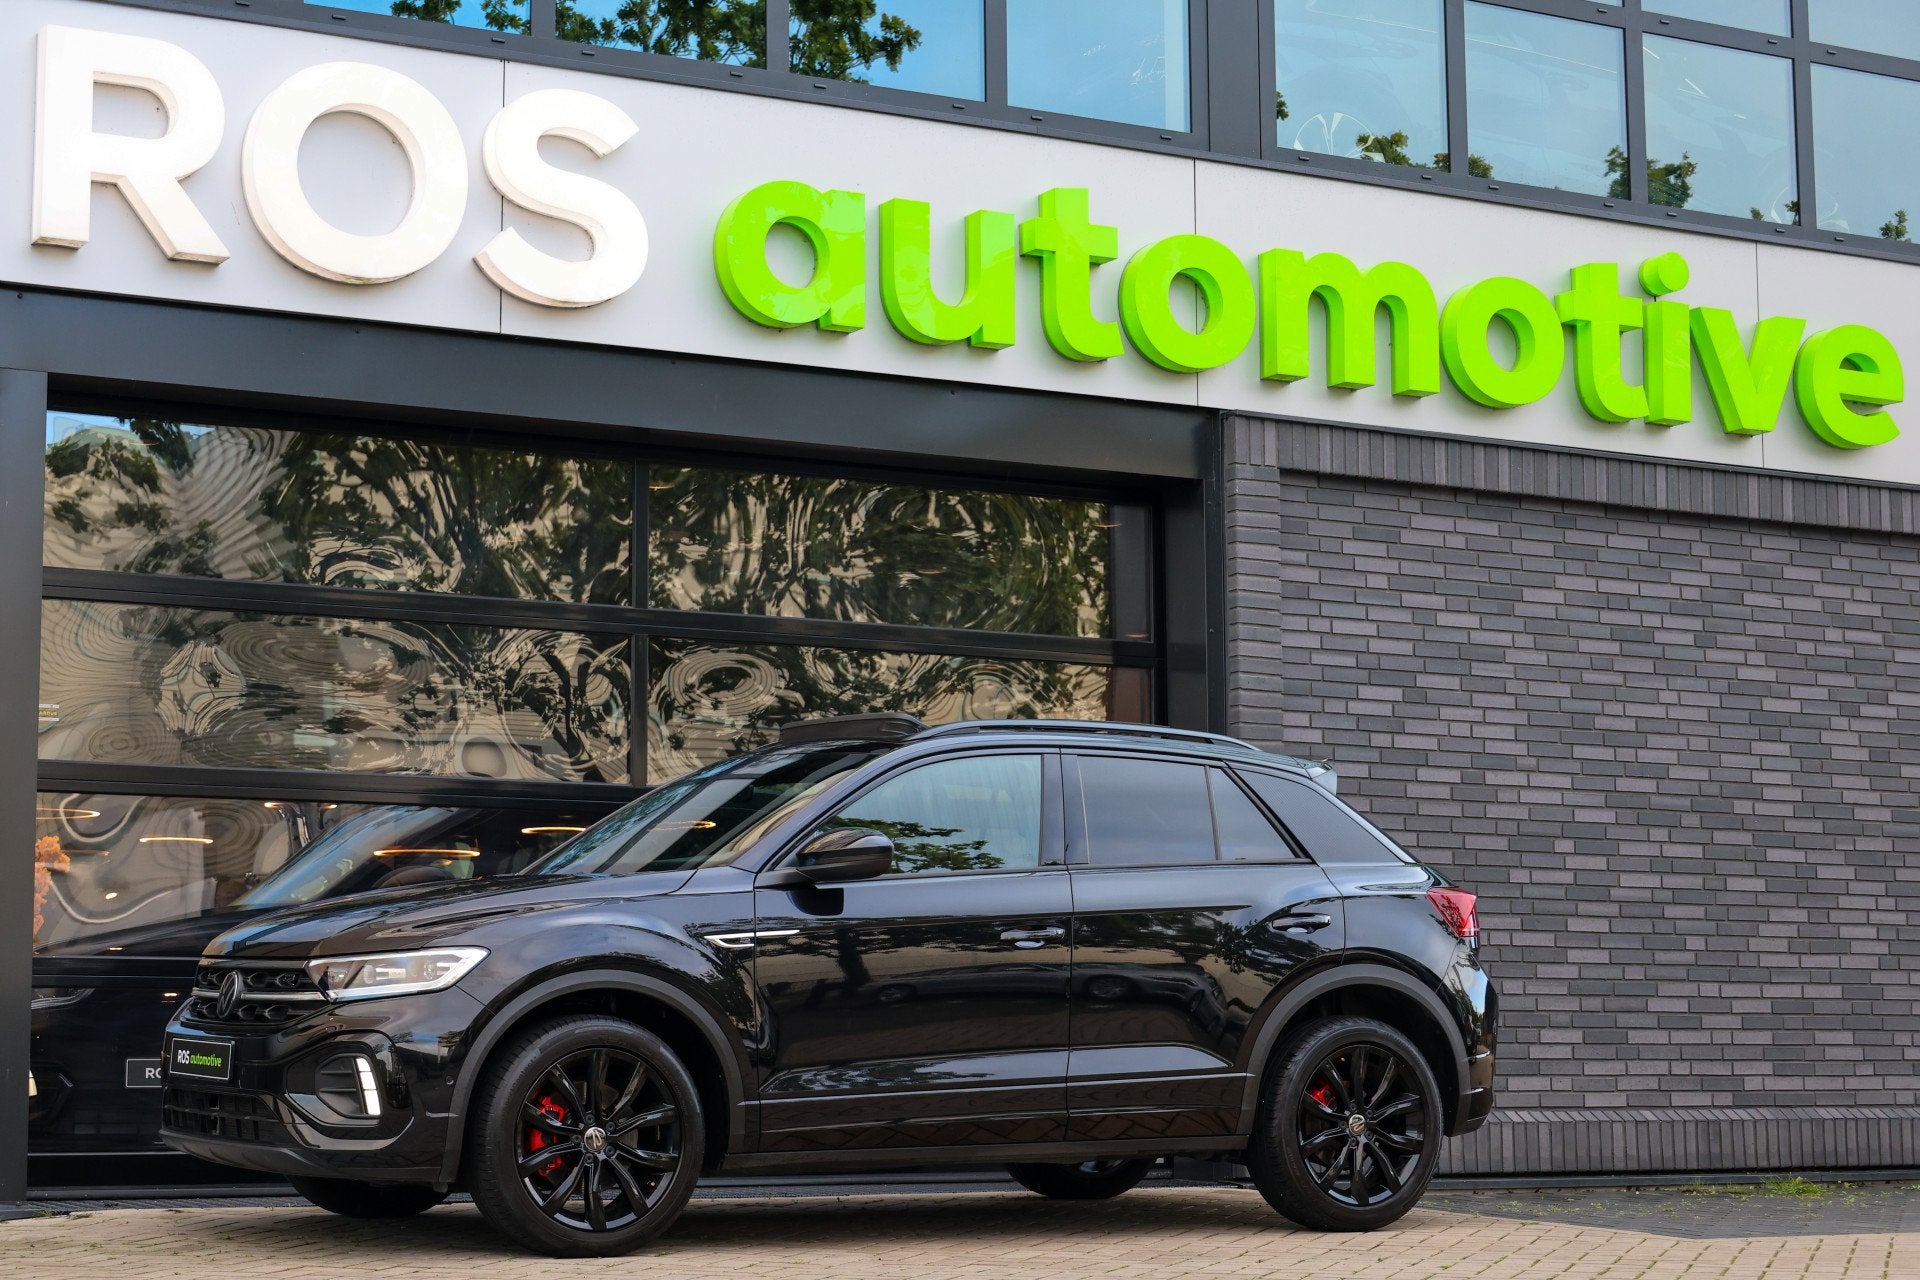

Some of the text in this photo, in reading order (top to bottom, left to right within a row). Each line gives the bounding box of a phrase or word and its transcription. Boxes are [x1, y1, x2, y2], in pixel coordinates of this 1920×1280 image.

[31, 24, 1904, 450] ROS automotive
[177, 1049, 222, 1067] ROS automotive
